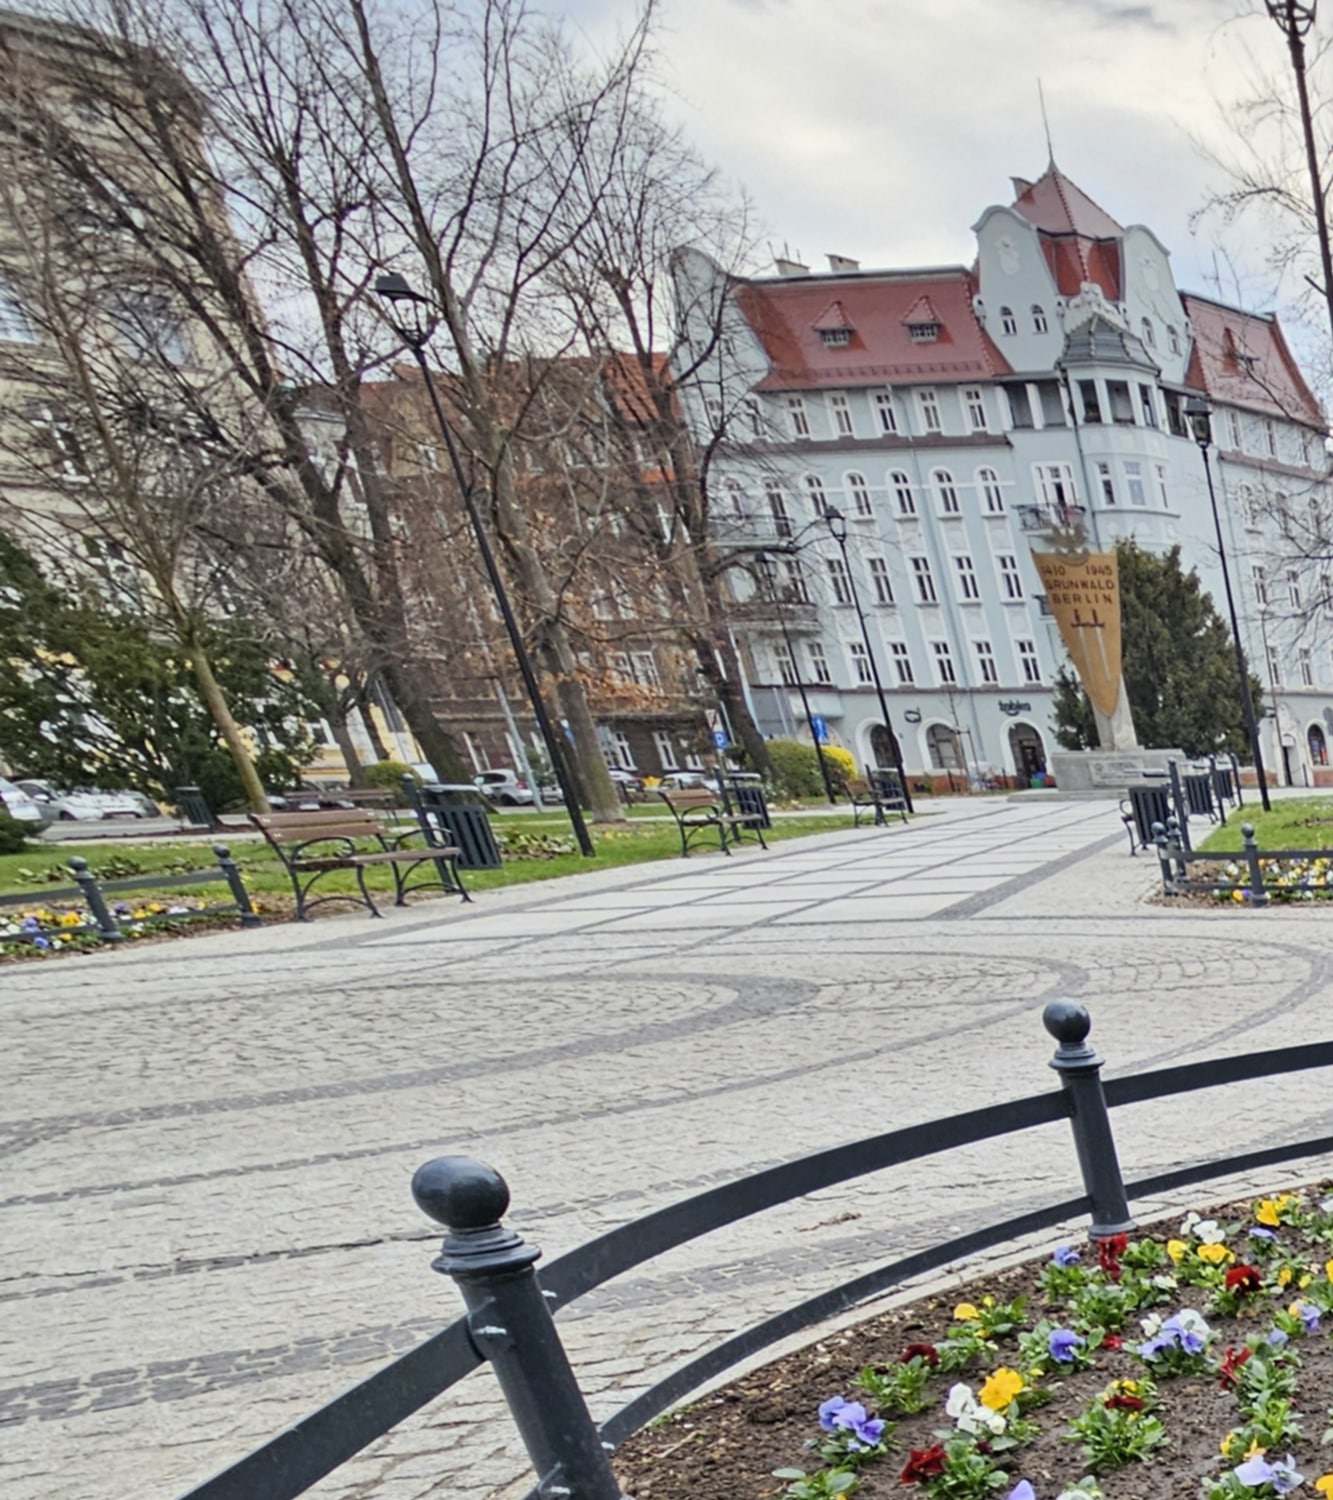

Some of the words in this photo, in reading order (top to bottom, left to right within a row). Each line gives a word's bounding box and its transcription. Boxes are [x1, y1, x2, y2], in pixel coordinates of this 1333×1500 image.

[1085, 565, 1113, 576] 1945
[1045, 579, 1115, 590] GRUNWALD
[1052, 593, 1112, 604] BERLIN
